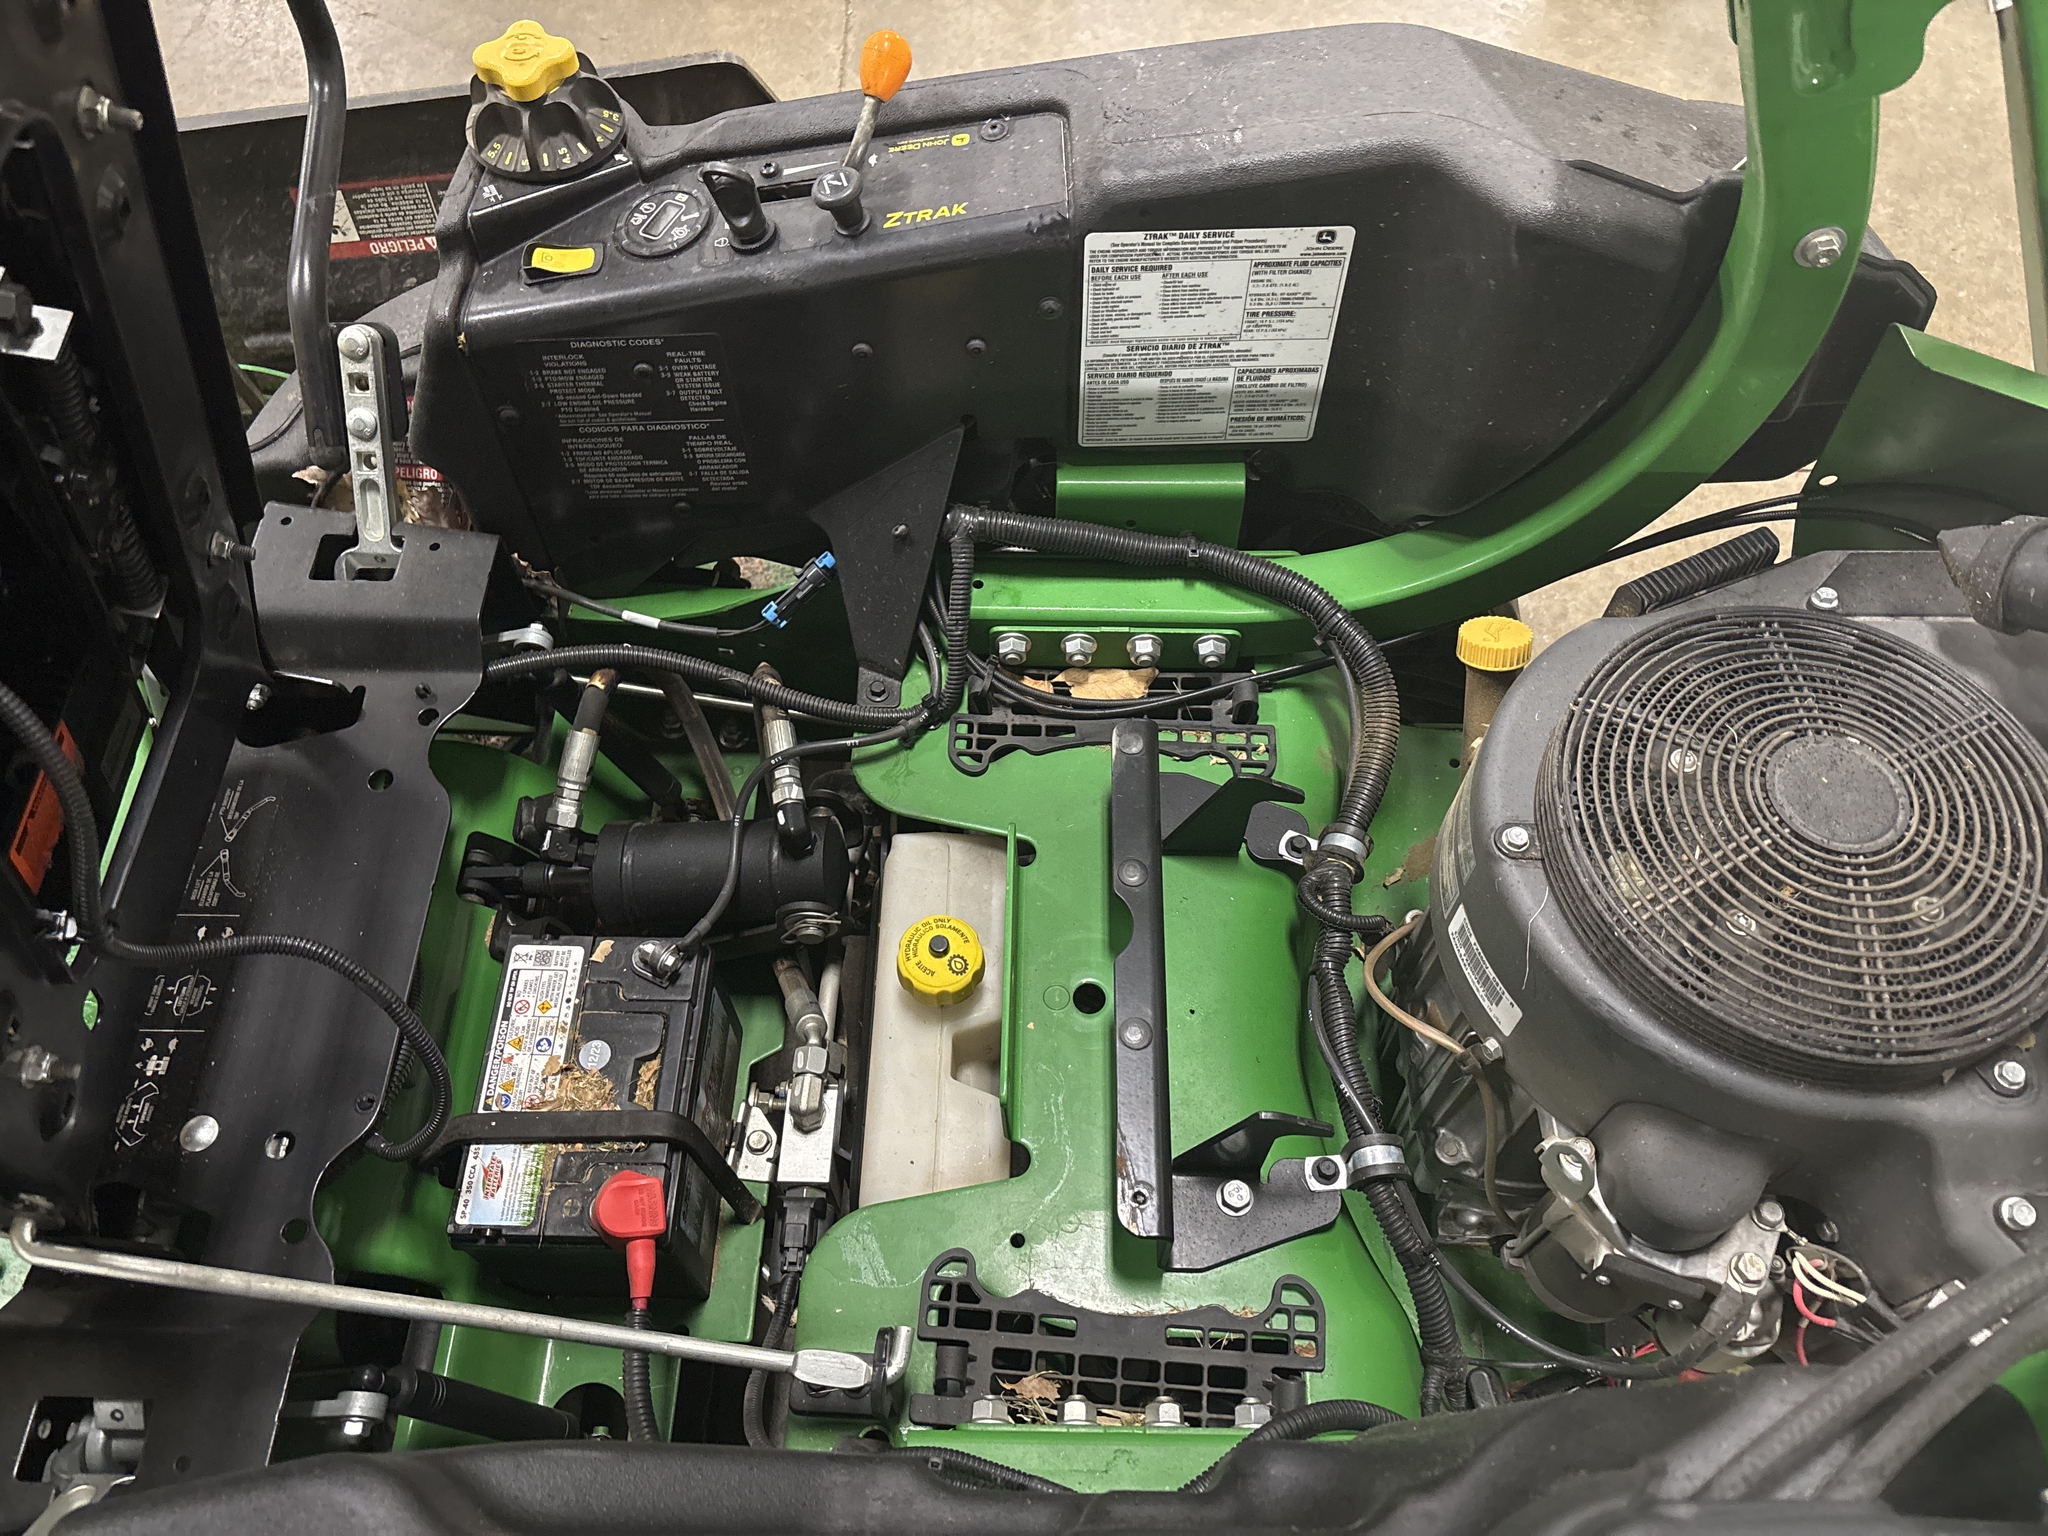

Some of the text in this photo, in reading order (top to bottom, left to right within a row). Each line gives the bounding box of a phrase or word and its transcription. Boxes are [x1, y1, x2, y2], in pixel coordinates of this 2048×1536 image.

[602, 110, 619, 121] 3.5
[487, 142, 501, 159] 5.5
[888, 143, 920, 153] DEERE
[922, 139, 950, 148] JOHN
[883, 202, 968, 228] ZTRAK
[1202, 231, 1235, 239] SERVICE
[369, 238, 426, 254] PELIGRO
[570, 340, 627, 348] DIAGNOSTIC
[395, 468, 437, 480] PELIGRO
[905, 927, 921, 962] HYDRAULIC
[912, 924, 970, 977] ACEITE HIDRAULICO SOLAMENTE
[487, 1021, 508, 1096] DANGER/POISON
[587, 1042, 602, 1067] 12/23
[468, 1164, 477, 1179] CCA
[483, 1155, 497, 1200] INTERSTATE
[490, 1159, 501, 1199] BATTERIES
[465, 1181, 473, 1194] 350
[460, 1199, 470, 1219] SP-40
